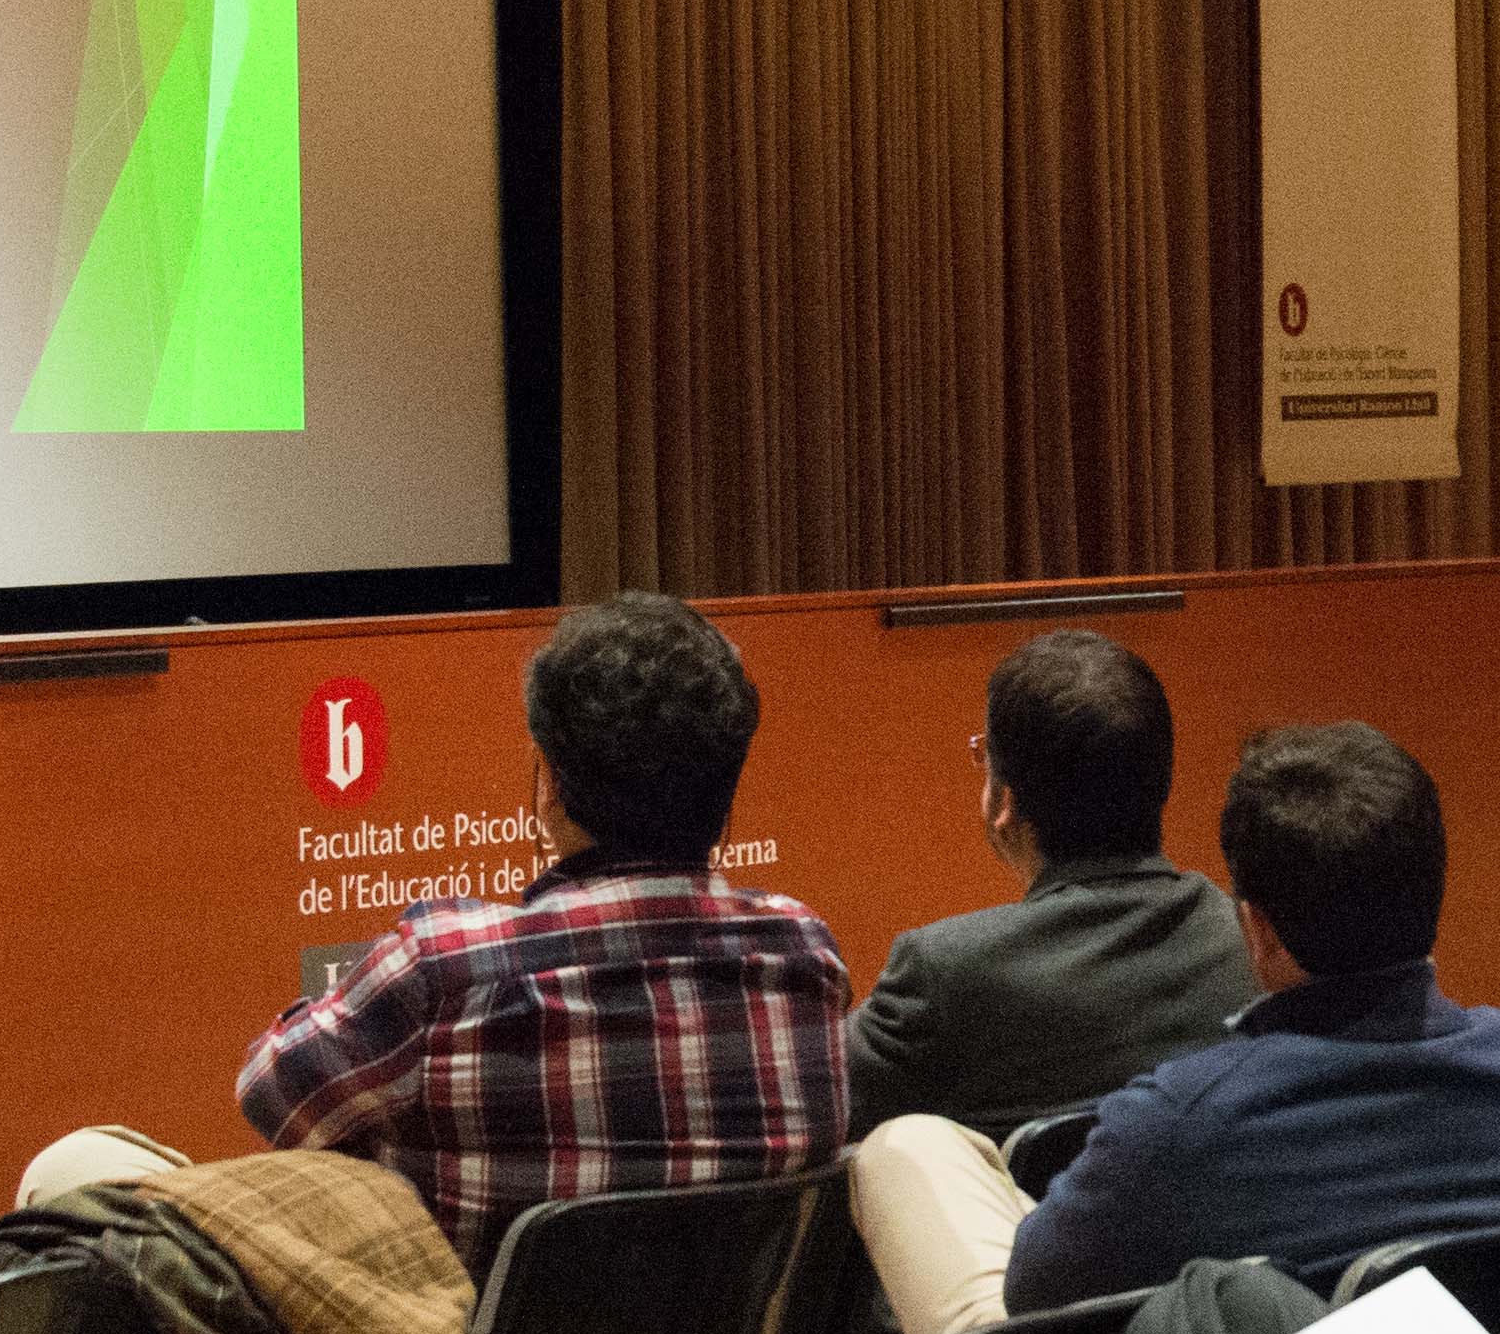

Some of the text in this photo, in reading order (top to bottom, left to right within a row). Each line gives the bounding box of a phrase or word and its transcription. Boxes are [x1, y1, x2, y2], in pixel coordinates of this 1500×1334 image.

[299, 819, 405, 863] Facultat
[412, 814, 446, 851] de
[299, 878, 332, 916] de
[479, 862, 485, 896] i
[493, 858, 525, 895] de
